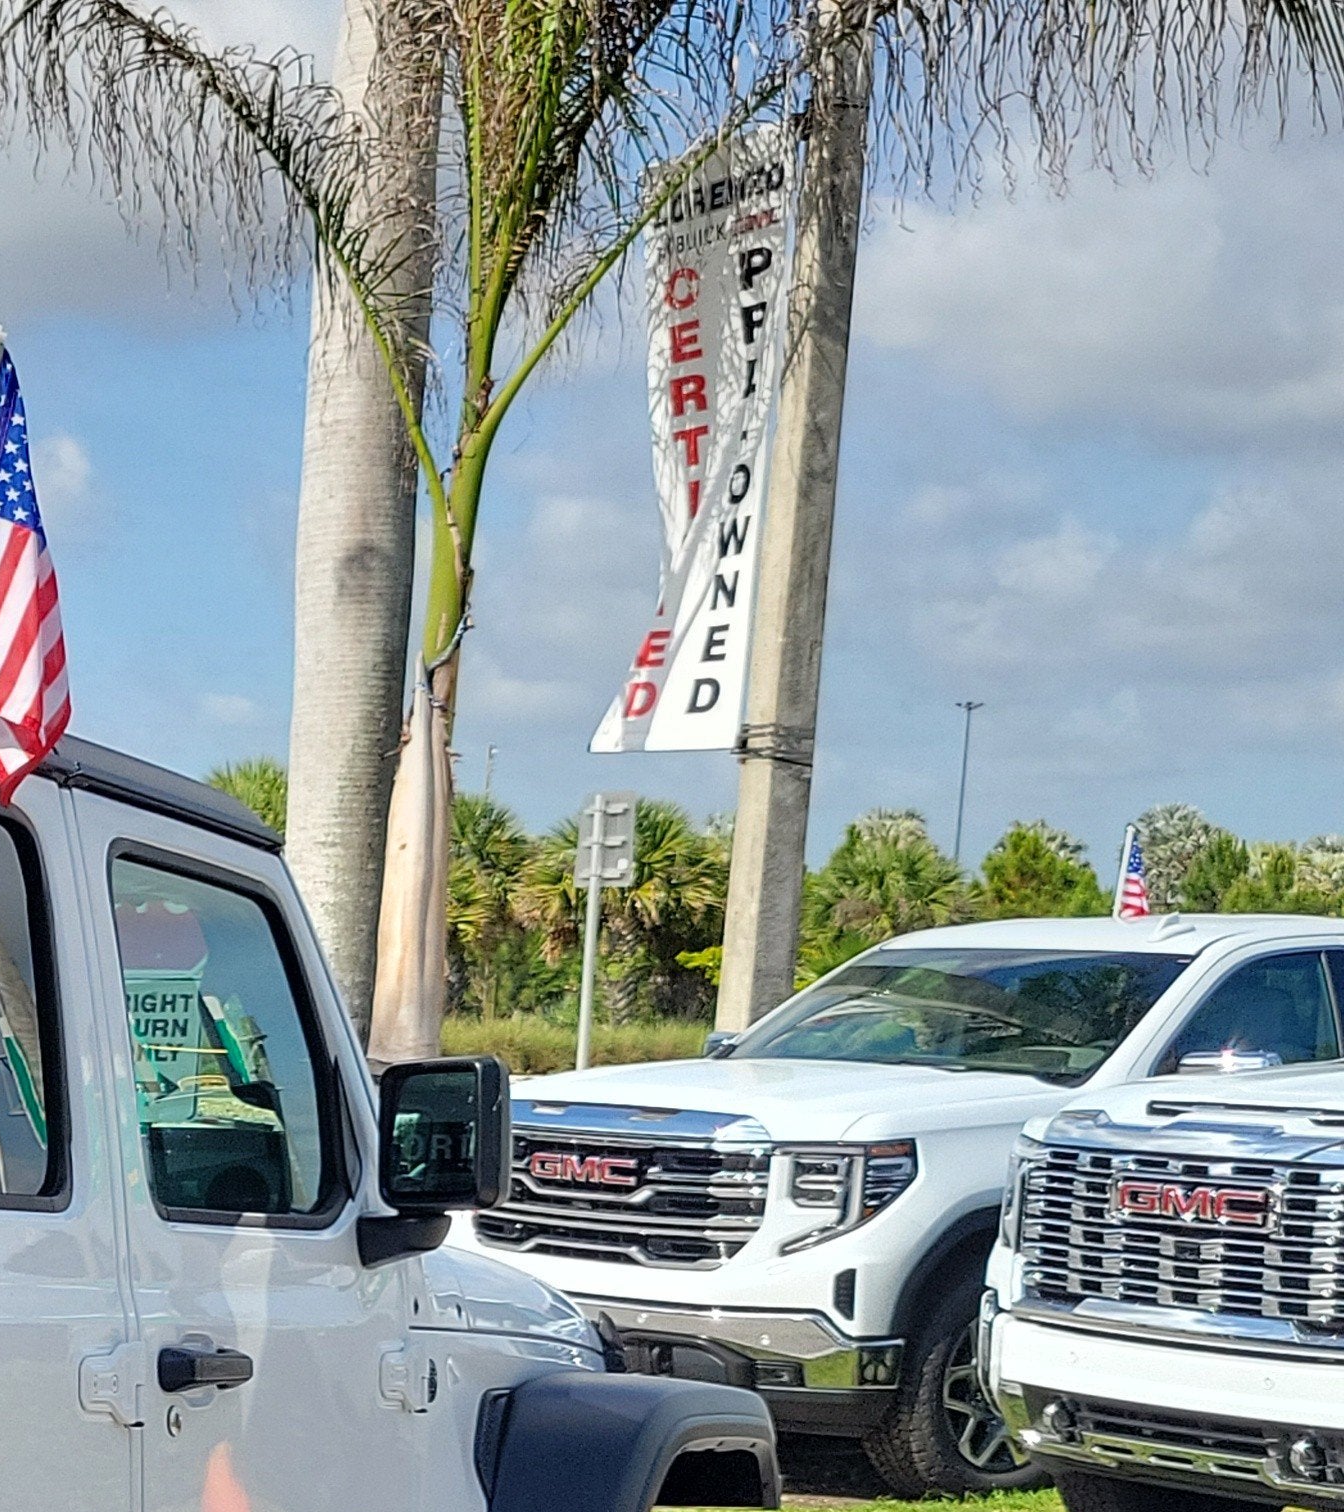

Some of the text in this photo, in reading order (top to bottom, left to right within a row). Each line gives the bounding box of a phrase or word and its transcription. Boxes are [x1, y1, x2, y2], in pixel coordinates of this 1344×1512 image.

[134, 1018, 188, 1037] URN
[529, 1152, 638, 1186] GMC
[1117, 1180, 1265, 1225] GMC
